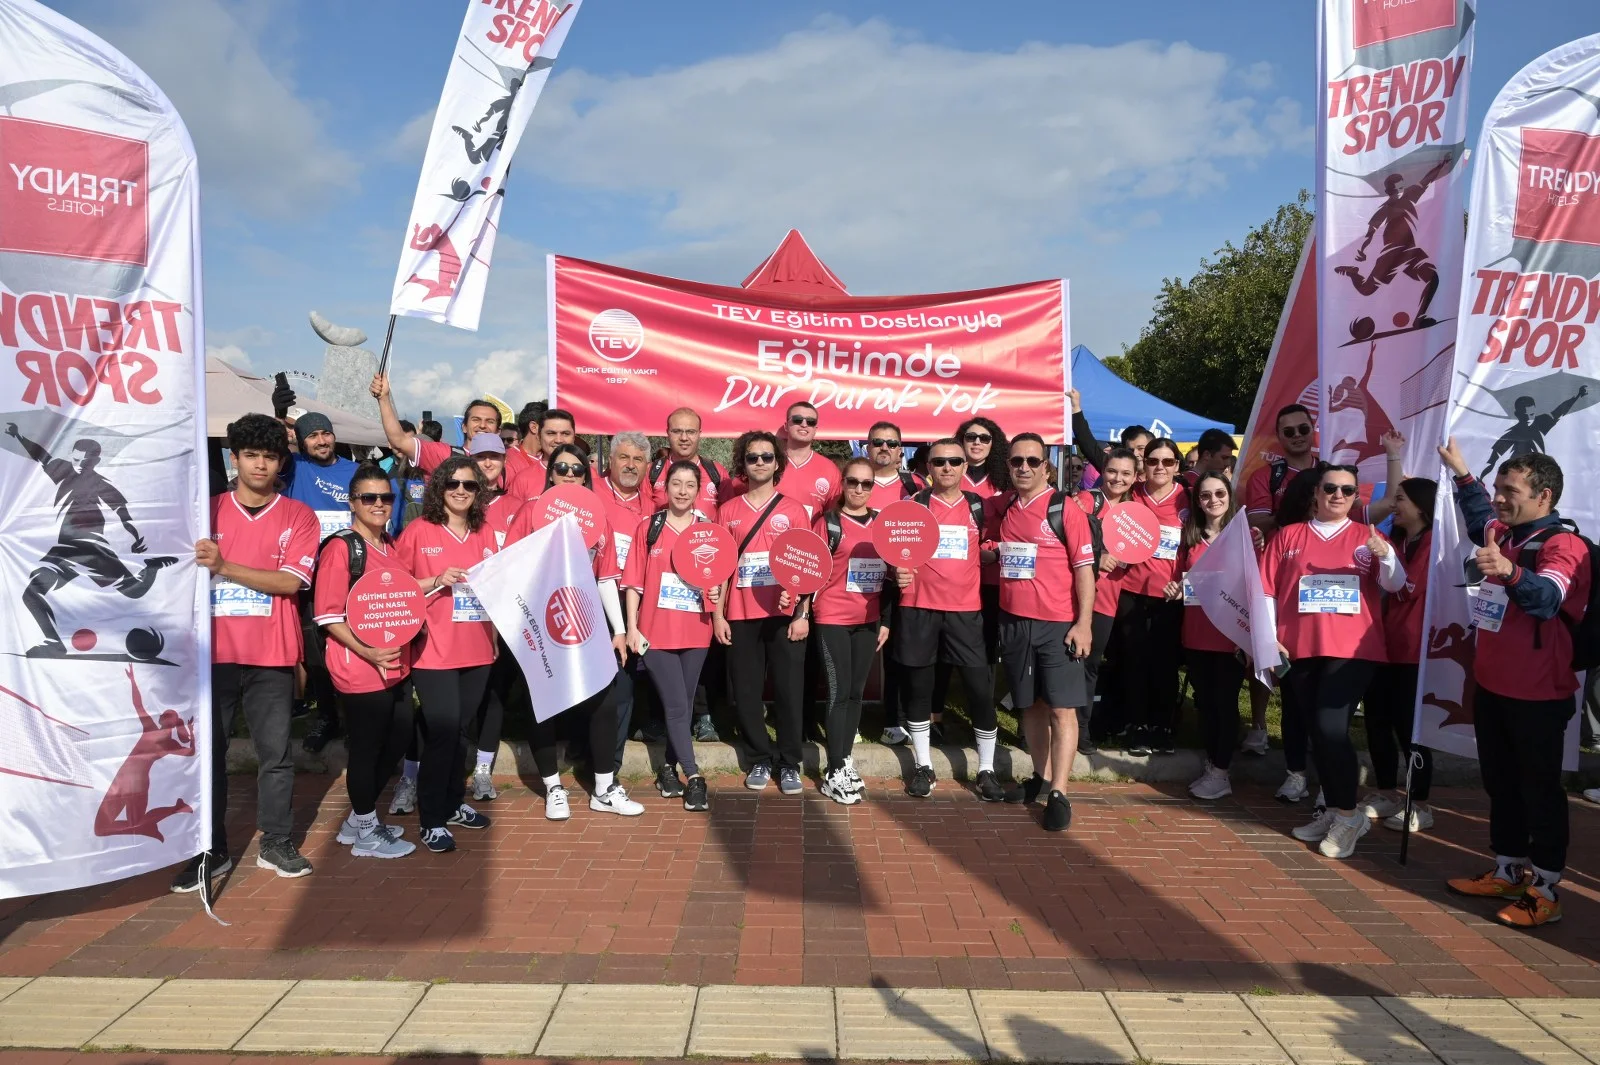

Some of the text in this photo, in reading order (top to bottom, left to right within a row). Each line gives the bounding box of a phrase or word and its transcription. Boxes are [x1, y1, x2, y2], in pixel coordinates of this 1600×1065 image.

[486, 14, 545, 63] SPO
[1328, 55, 1466, 119] TRENDY
[1342, 101, 1446, 156] SPOR
[1527, 164, 1600, 195] TRENDY
[1471, 269, 1600, 325] TRENDY
[712, 304, 1002, 333] TEV Eğitim Dostlarıyla
[595, 336, 639, 349] TEV
[1477, 318, 1586, 370] SPOR
[757, 339, 961, 383] Eğitimde
[576, 366, 600, 374] TÜRK
[633, 368, 658, 376] VAKFI
[713, 375, 1001, 416] Dur Durak Yok
[554, 498, 593, 518] Eğitim için
[544, 513, 555, 521] ne
[584, 519, 595, 528] da
[897, 520, 926, 528] koşarız,
[891, 528, 919, 536] gelecek
[1112, 514, 1131, 532] eğitim
[1131, 529, 1153, 549] aşkımız
[1120, 510, 1154, 541] Tempomuzu
[693, 530, 714, 538] TEV
[888, 535, 923, 543] şekillenir.
[1117, 527, 1139, 547] belirler.
[940, 538, 965, 546] 494
[421, 546, 444, 554] TRENDY
[786, 544, 820, 563] Yorgunluk,
[775, 555, 823, 579] koşunca güzel.
[783, 552, 819, 569] eğitim için
[1001, 555, 1032, 565] 12472
[740, 565, 771, 575] 1249
[852, 572, 885, 580] 12489
[357, 590, 417, 601] EĞİTİME DESTEK
[458, 597, 480, 606] 124
[1304, 589, 1355, 599] 12487
[368, 602, 384, 610] İÇİN
[364, 610, 413, 620] KOŞUYORUM,
[550, 595, 578, 641] TEV
[357, 618, 420, 630] OYNAT BAKALIM!
[1236, 618, 1251, 633] 196
[515, 594, 553, 678] TÜRK EĞİTİM VAKFI
[522, 628, 536, 651] 1967
